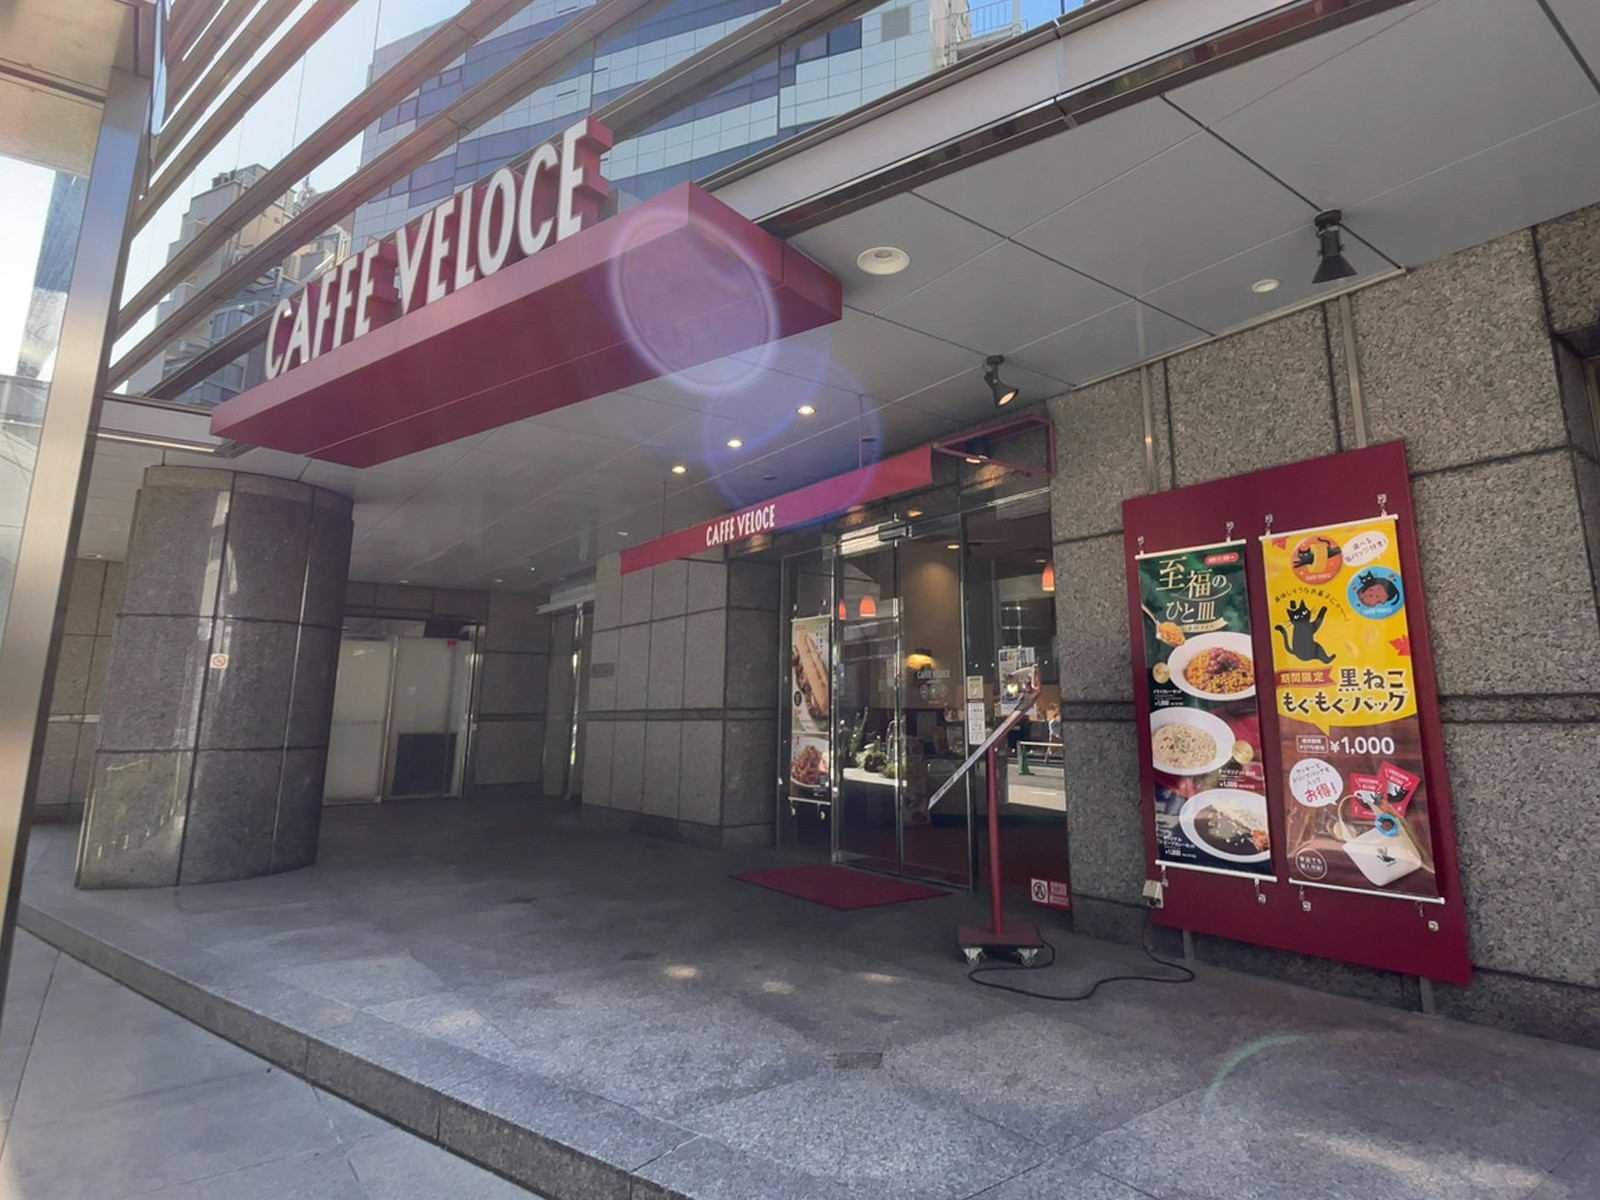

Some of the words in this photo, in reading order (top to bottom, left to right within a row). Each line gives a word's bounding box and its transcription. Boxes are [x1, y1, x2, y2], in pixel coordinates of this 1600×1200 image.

[265, 241, 380, 380] CAFFE
[396, 117, 588, 316] VELOCE
[706, 516, 735, 547] CAFFE
[737, 504, 775, 536] VELOCE
[1156, 556, 1230, 599] 至福の
[1166, 601, 1216, 623] ひと皿
[1280, 671, 1325, 684] 期間限定
[1338, 668, 1405, 692] 黒ねこ
[1283, 690, 1408, 714] もぐもぐバッグ
[1330, 736, 1395, 755] ¥1,000
